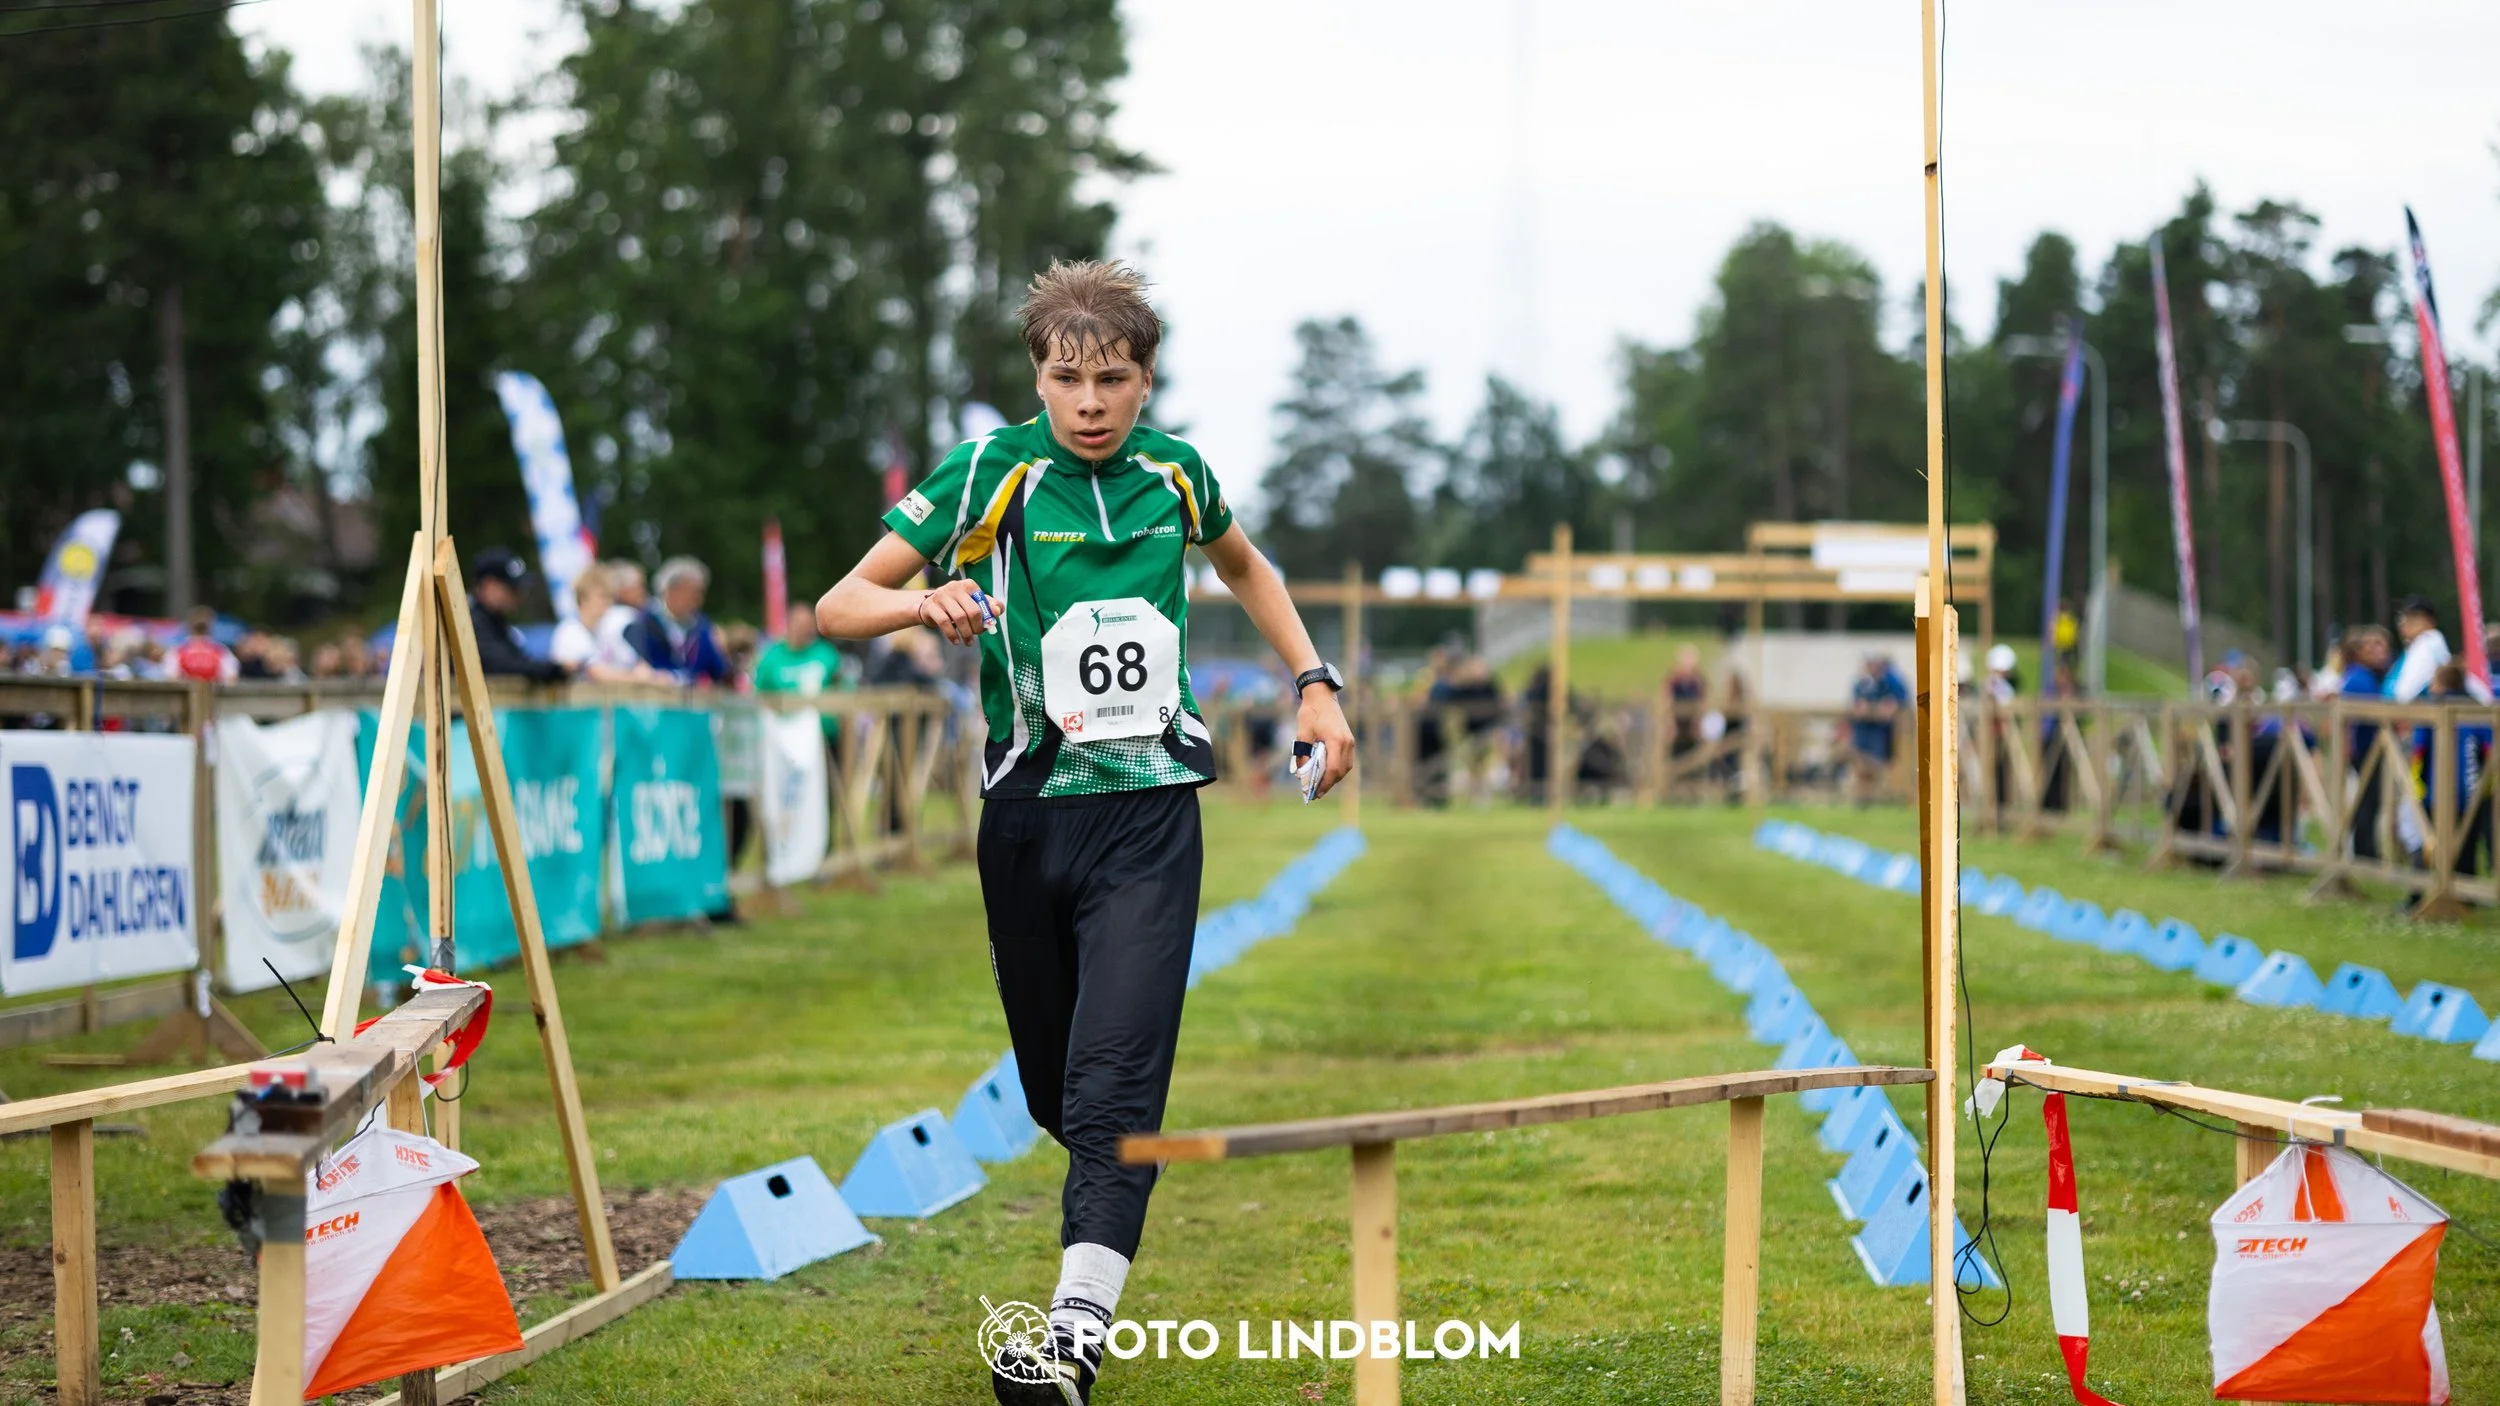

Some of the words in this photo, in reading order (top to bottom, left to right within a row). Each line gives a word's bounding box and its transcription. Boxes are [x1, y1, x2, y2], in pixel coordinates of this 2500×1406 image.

[1033, 530, 1087, 542] TRIMTEX
[1132, 525, 1176, 539] robotron
[1079, 641, 1148, 696] 68
[1159, 706, 1170, 723] 8
[67, 780, 140, 846] BENGT
[69, 866, 188, 940] DAHLGREN
